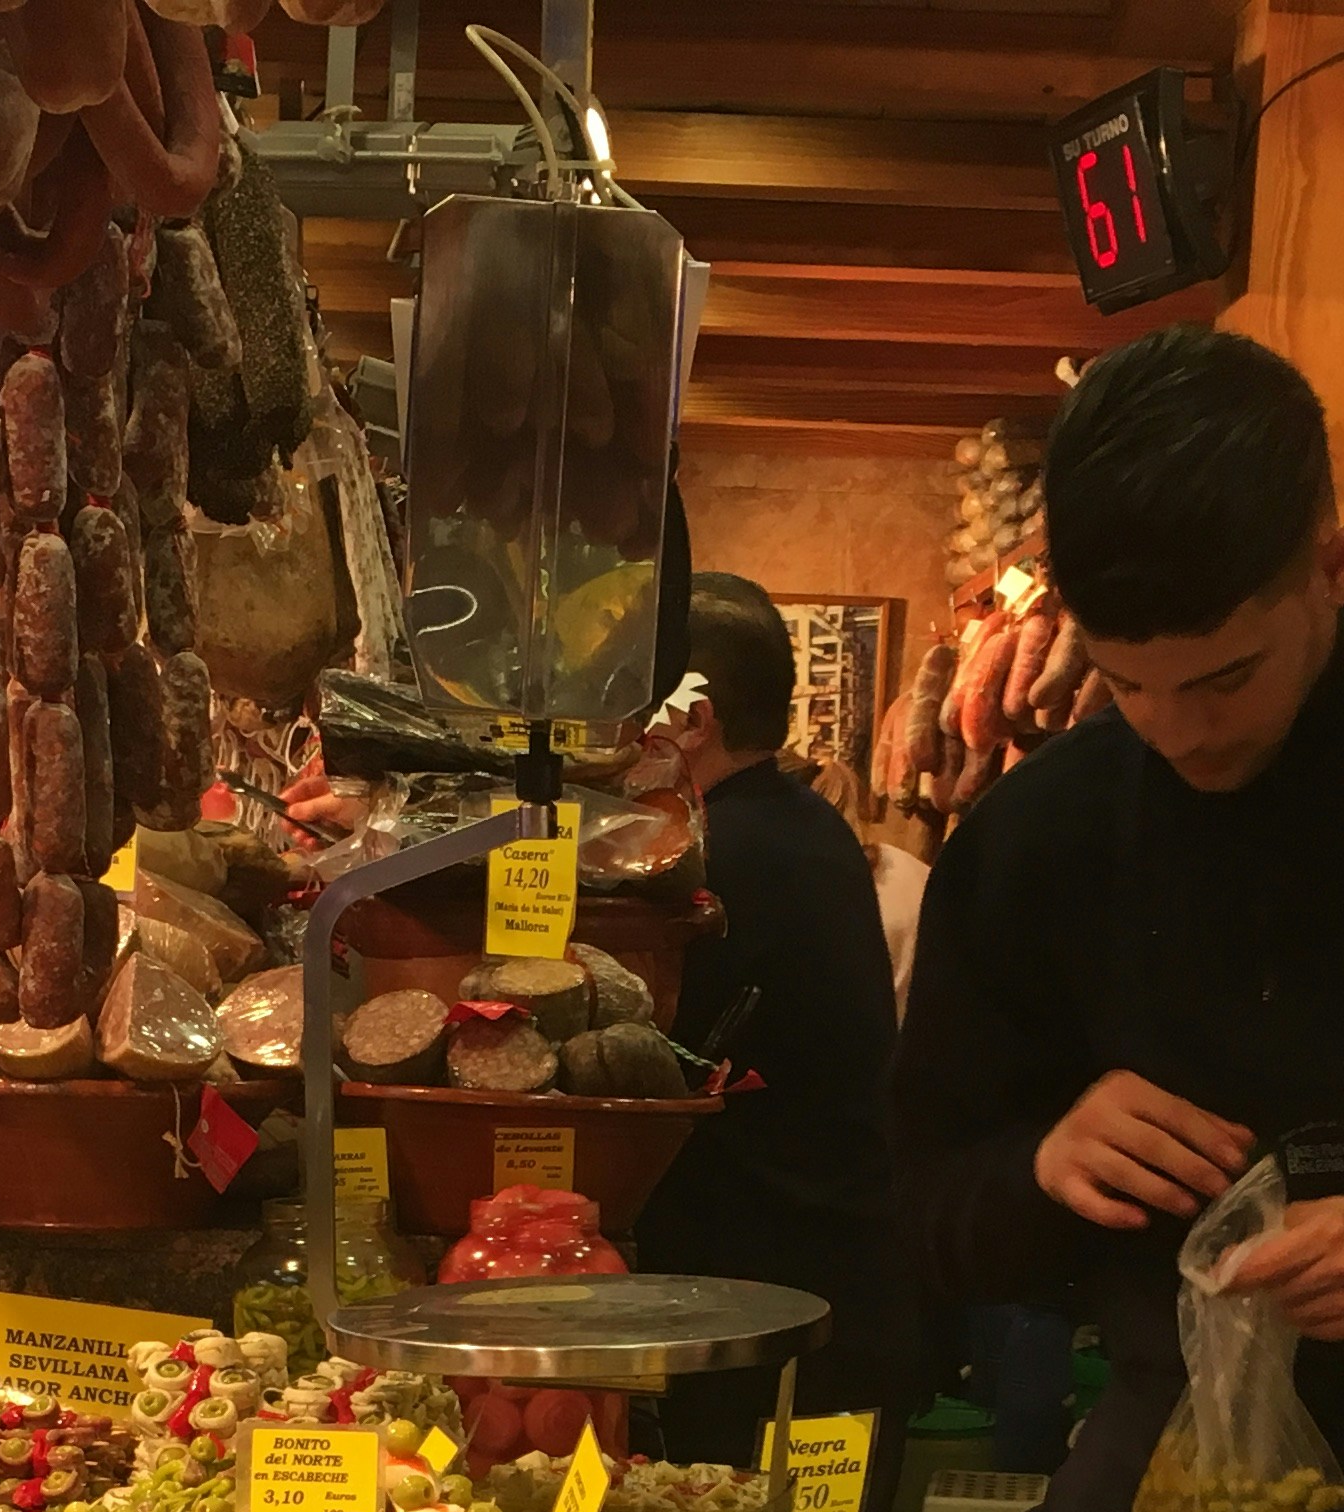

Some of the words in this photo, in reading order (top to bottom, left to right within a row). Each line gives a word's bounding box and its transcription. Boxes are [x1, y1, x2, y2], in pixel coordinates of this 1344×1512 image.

[1063, 141, 1081, 161] SU
[1083, 113, 1129, 150] TURNO
[1076, 144, 1147, 269] 61
[504, 867, 549, 891] 14,20
[505, 918, 550, 933] Mallorca
[495, 1132, 562, 1141] CEBOLLAS
[5, 1328, 130, 1359] MANZANILL
[9, 1353, 129, 1383] SEVILLANA
[273, 1437, 331, 1451] BONITO
[788, 1439, 847, 1457] Negra
[264, 1453, 288, 1465] del
[291, 1454, 344, 1467] NORTE
[786, 1457, 861, 1479] ansida
[254, 1472, 269, 1481] en
[272, 1471, 349, 1484] ESCABECHE
[263, 1489, 305, 1507] 3,10
[325, 1491, 357, 1501] Euros
